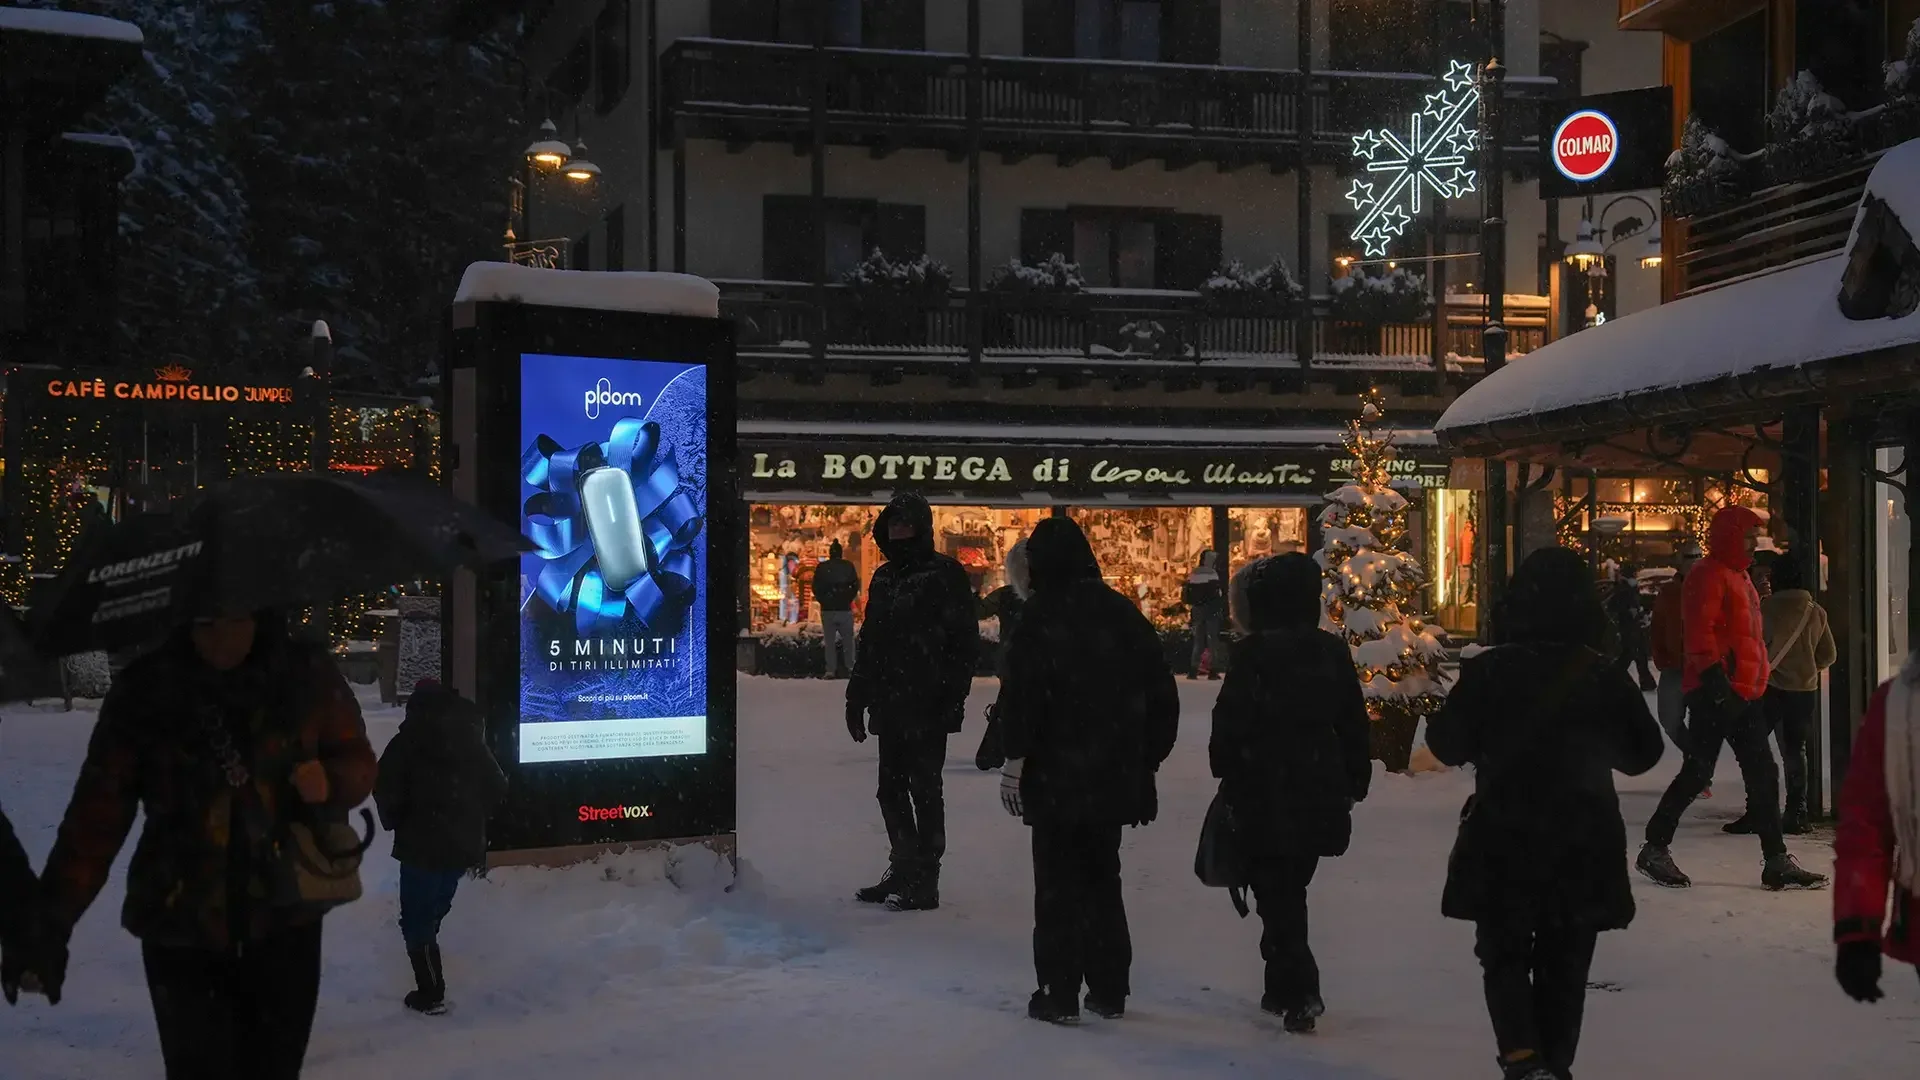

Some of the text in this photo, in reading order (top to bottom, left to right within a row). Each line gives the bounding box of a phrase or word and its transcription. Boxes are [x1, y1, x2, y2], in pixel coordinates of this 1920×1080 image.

[1560, 134, 1611, 157] COLMAR
[114, 382, 239, 402] CAMPIGLIO
[584, 377, 642, 420] ploom
[752, 453, 797, 478] La
[821, 454, 1013, 482] BOTTEGA
[1032, 458, 1071, 482] di
[1330, 459, 1417, 473] SHING
[550, 638, 675, 656] 5 MINUTI
[550, 661, 563, 671] DI
[570, 660, 597, 670] TIRI
[578, 804, 653, 822] Streetvox.
